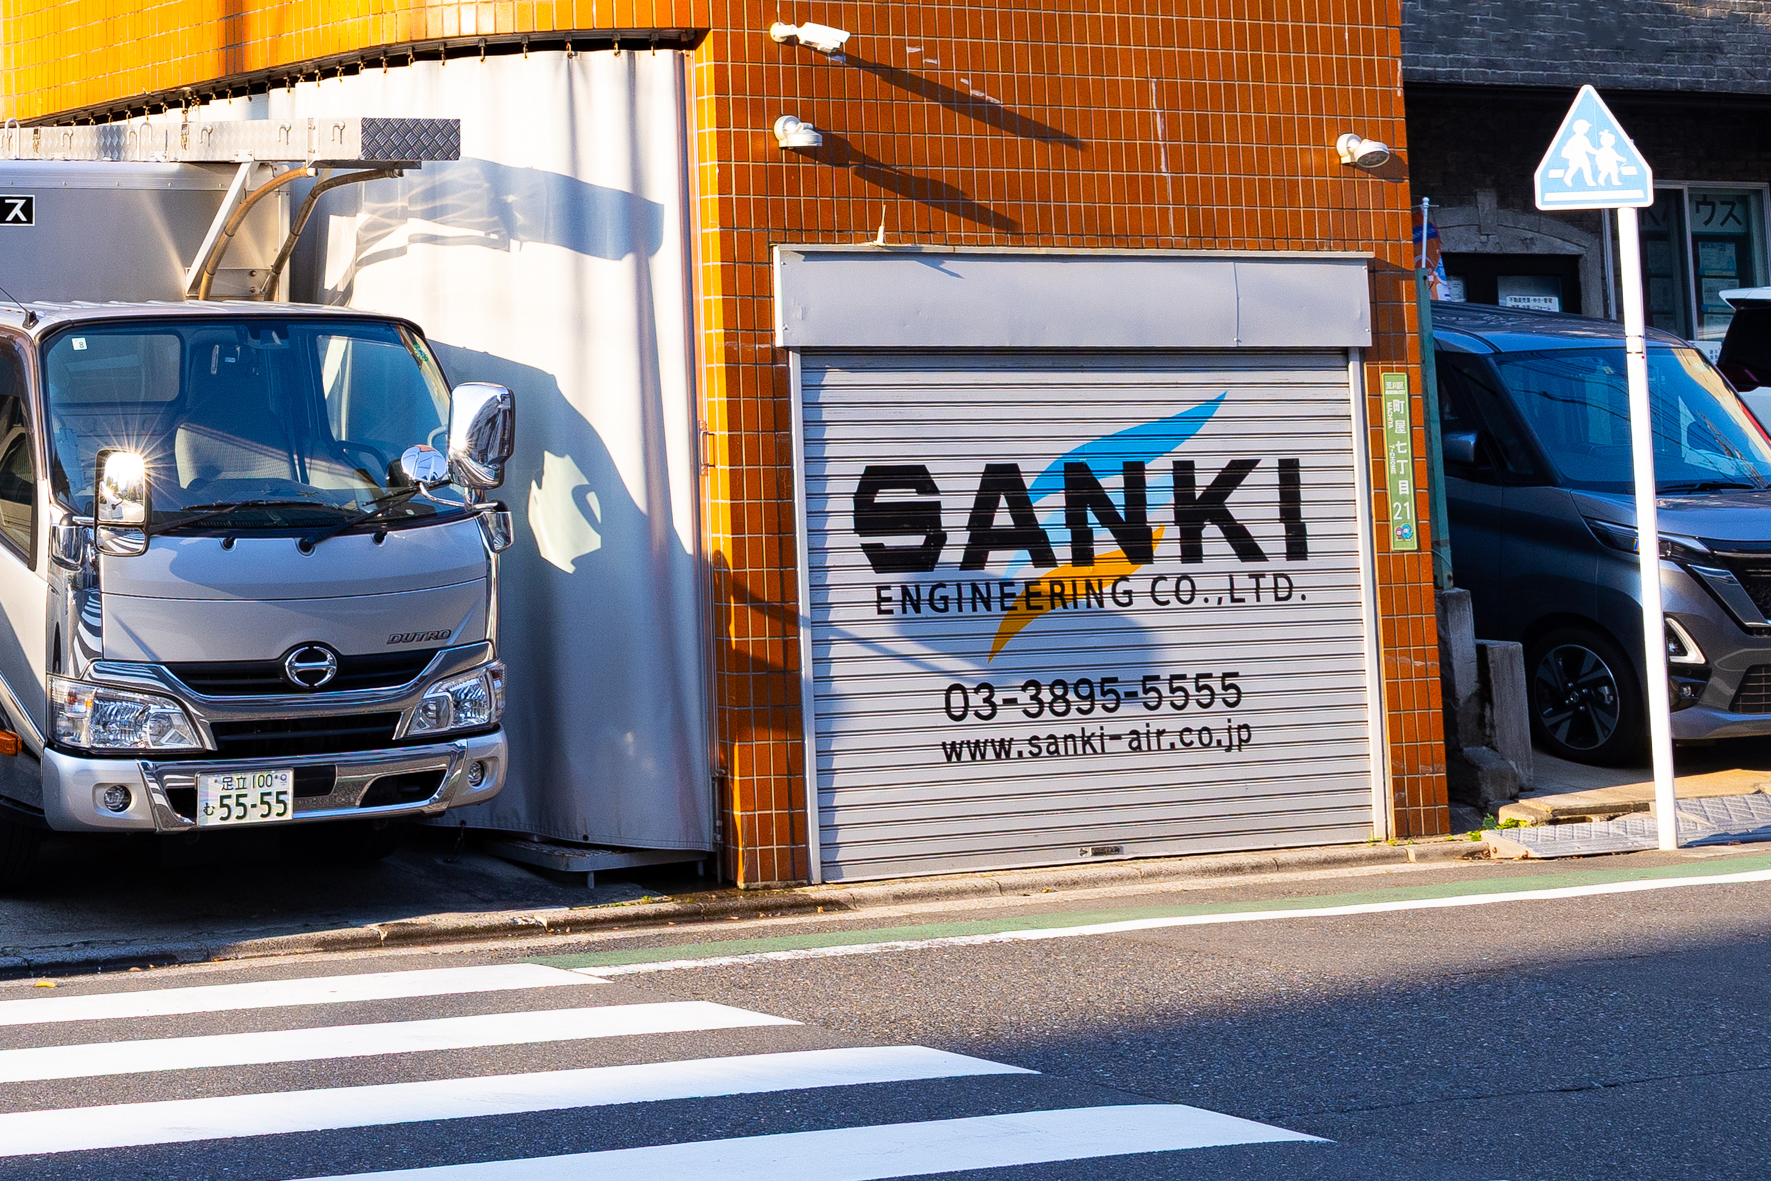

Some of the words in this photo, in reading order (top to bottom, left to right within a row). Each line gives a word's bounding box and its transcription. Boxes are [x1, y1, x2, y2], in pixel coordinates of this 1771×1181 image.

[1393, 399, 1410, 495] 町屋七丁目
[853, 458, 1308, 574] SANKI
[1393, 502, 1410, 520] 21
[875, 576, 1134, 616] ENGINEERING
[1150, 571, 1308, 608] CO.,LTD.
[386, 629, 452, 645] DUTRO
[943, 672, 1243, 722] 03-3895-5555
[941, 718, 1253, 762] www.sanki-air.co.jp
[221, 775, 248, 791] 足立
[251, 773, 273, 789] 100
[203, 802, 215, 816] む
[219, 791, 288, 821] 55-55
